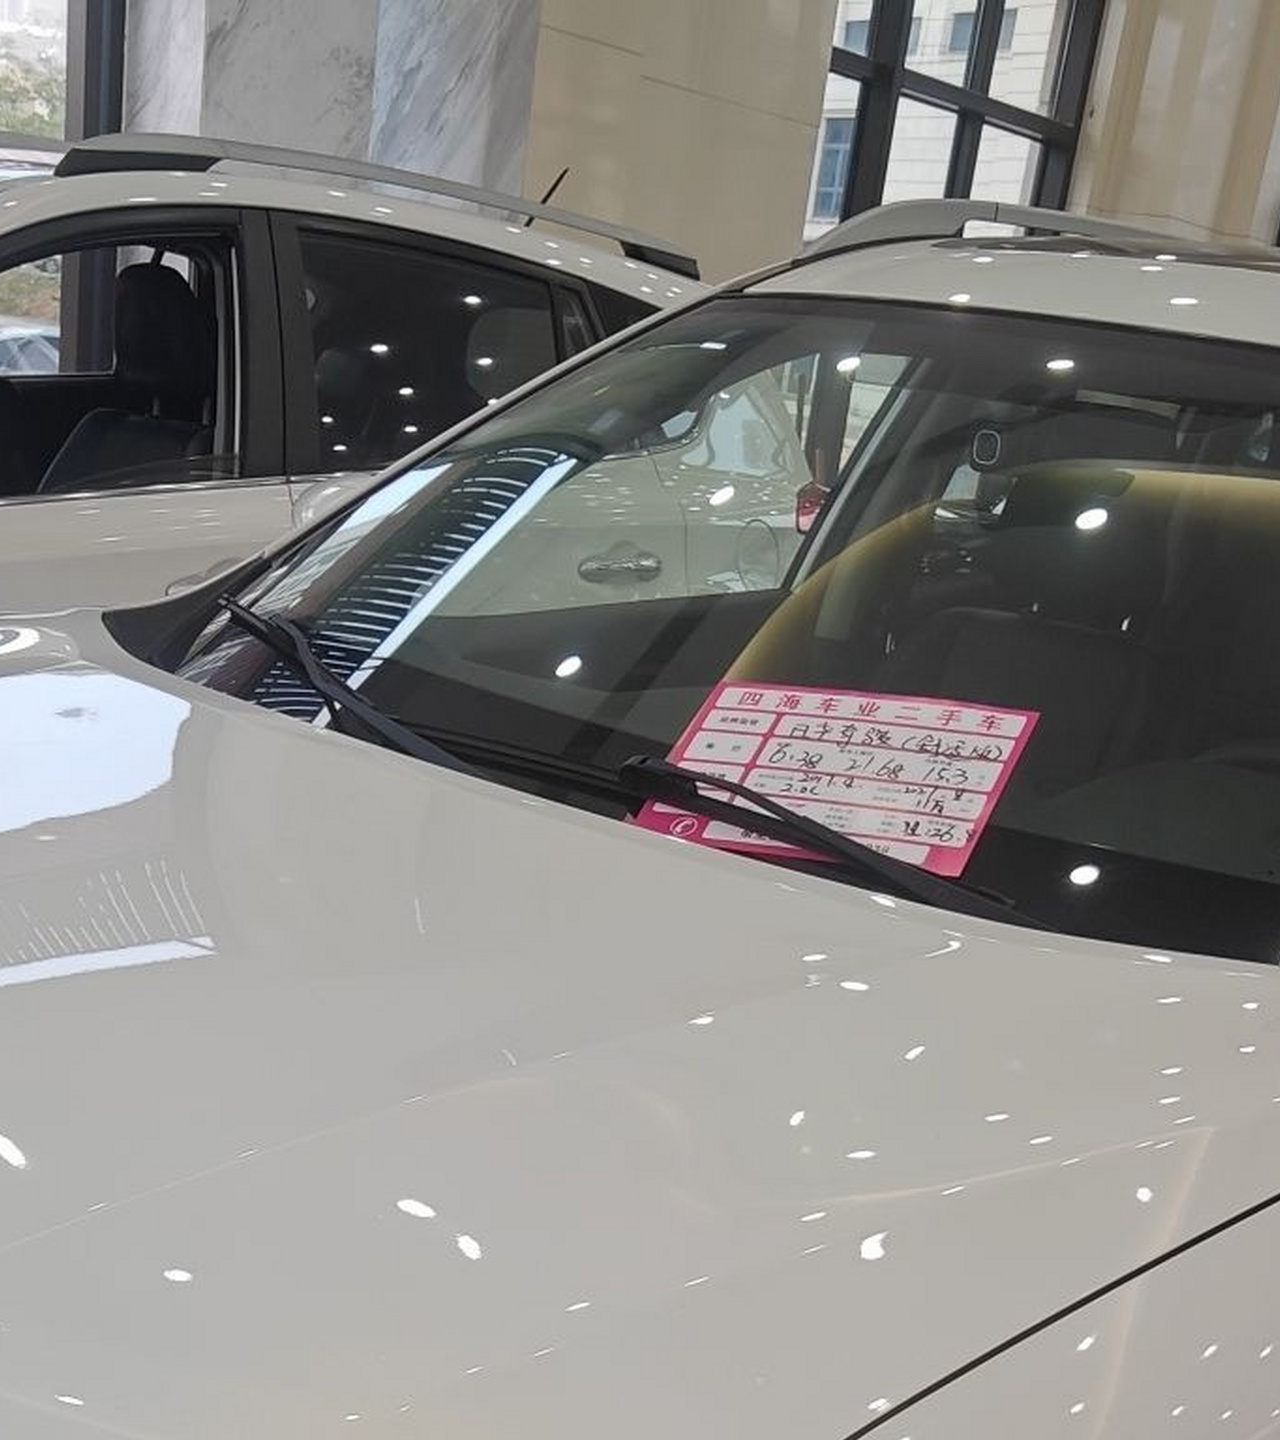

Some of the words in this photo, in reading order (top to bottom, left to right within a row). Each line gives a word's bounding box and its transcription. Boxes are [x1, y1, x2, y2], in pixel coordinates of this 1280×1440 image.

[738, 691, 1006, 731] 四海车业二手车
